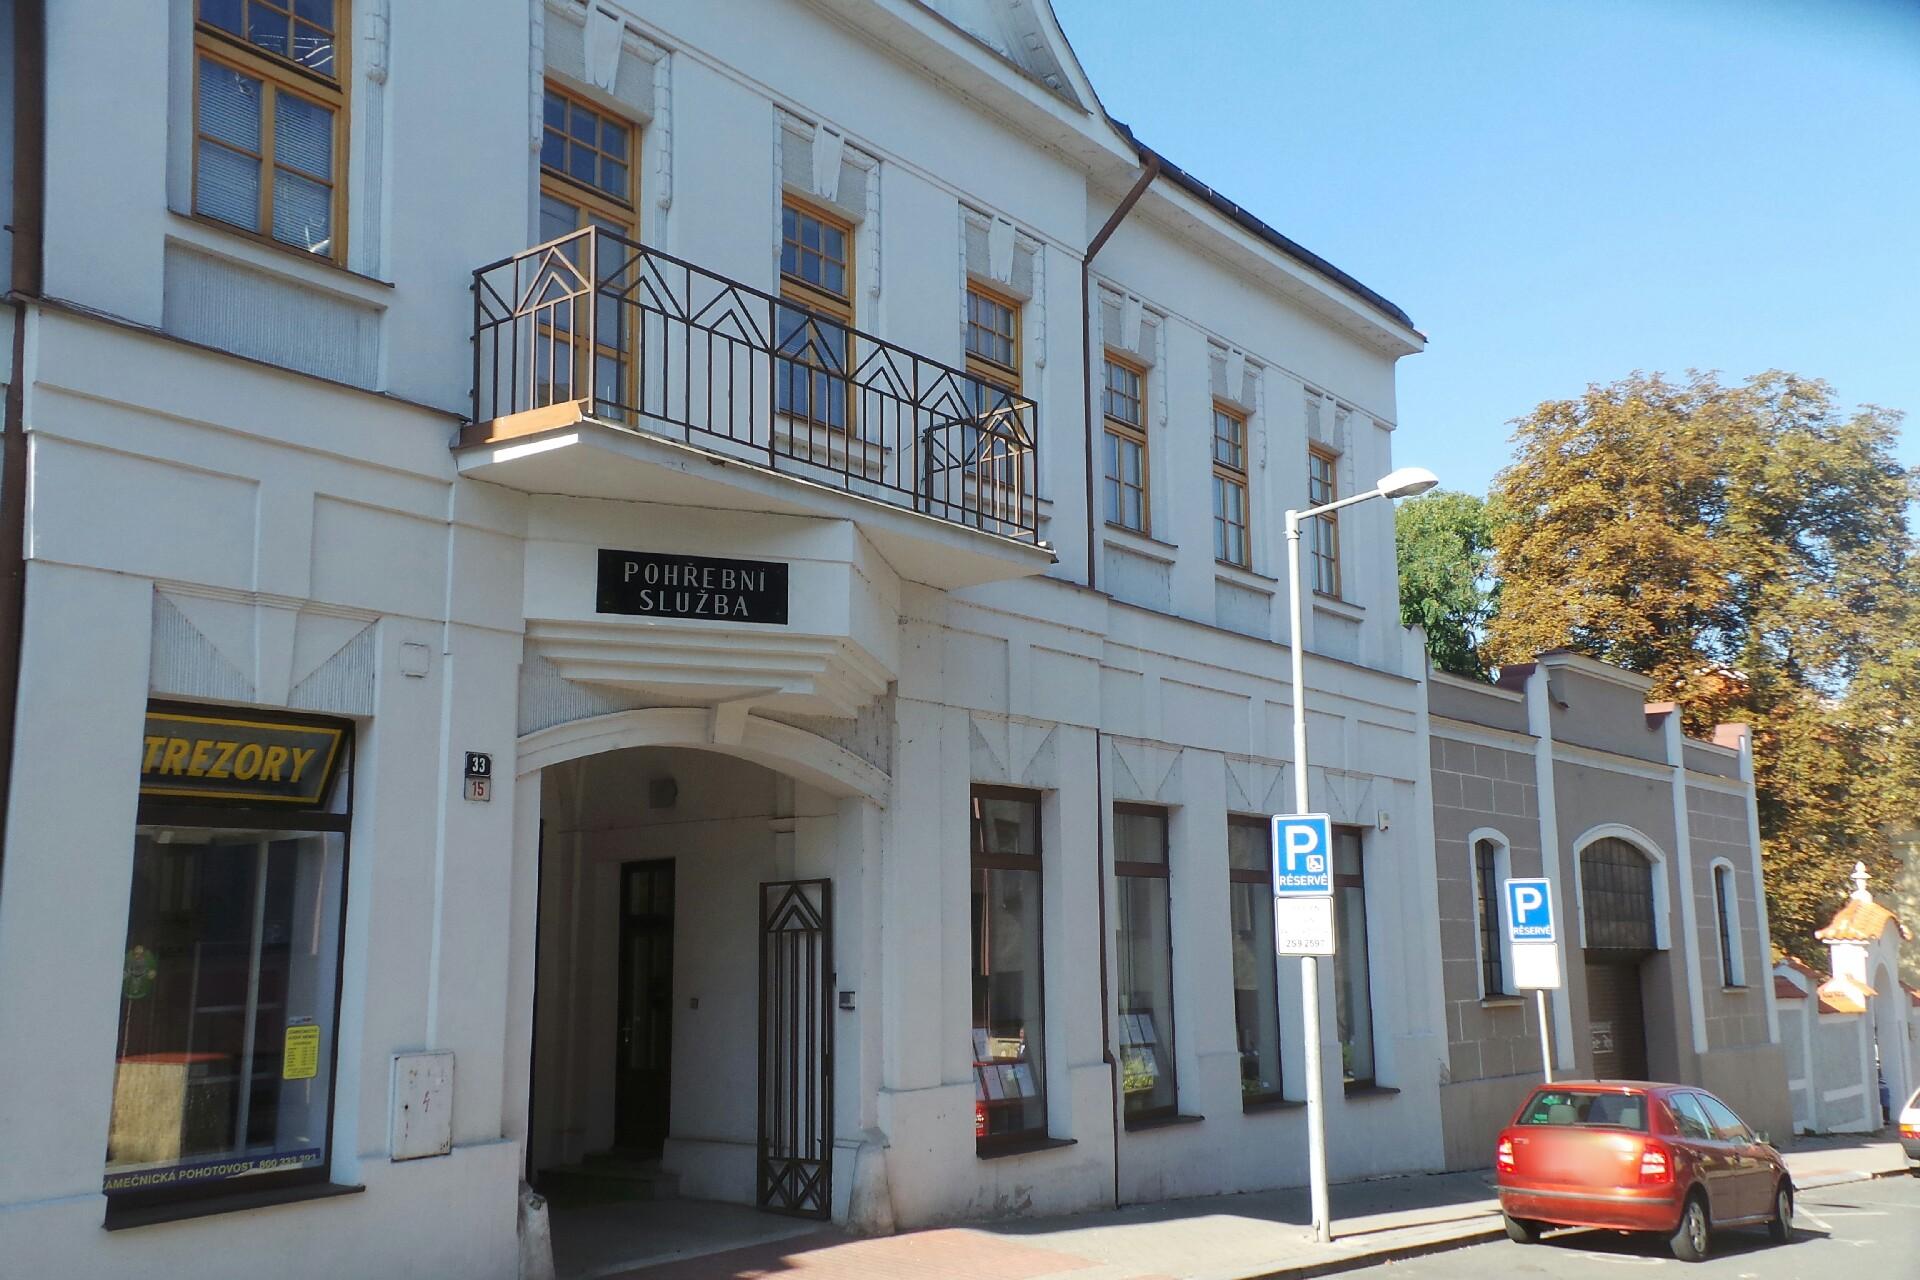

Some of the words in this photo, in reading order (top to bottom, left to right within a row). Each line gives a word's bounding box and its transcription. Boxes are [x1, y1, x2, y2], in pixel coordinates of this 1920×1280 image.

[624, 561, 765, 592] POHŘEBNÍ
[639, 589, 749, 617] SLUŽBA
[141, 736, 316, 783] TREZORY
[472, 757, 486, 773] 33
[472, 781, 484, 797] 15
[1285, 825, 1319, 871] P
[1279, 873, 1329, 886] RÉSERVÉ
[1515, 887, 1543, 924] P
[1513, 924, 1552, 935] RÉSERVÉ
[104, 1168, 176, 1190] AMEČNICKÁ
[178, 1161, 255, 1181] POHOTOVOST
